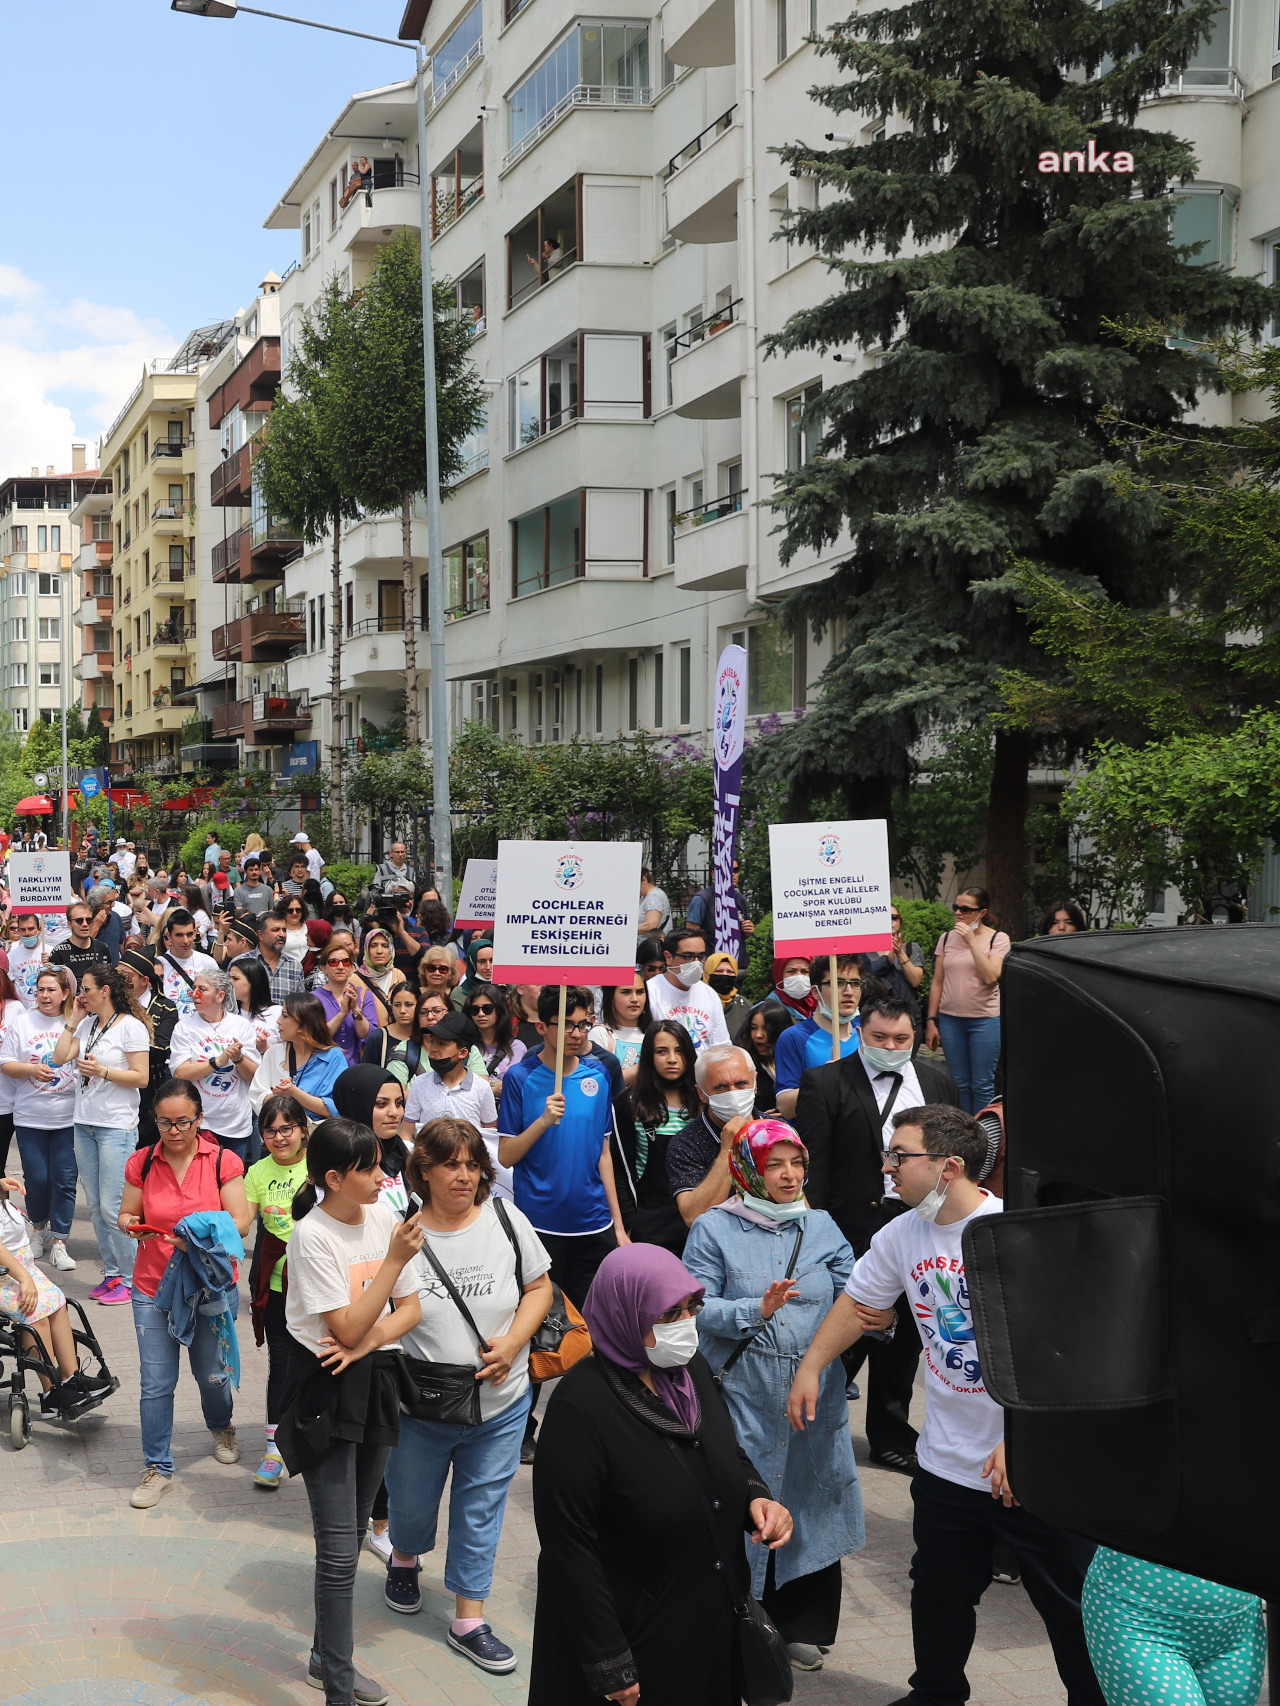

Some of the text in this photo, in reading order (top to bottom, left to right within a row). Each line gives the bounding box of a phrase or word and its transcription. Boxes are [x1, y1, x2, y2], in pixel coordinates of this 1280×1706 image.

[798, 874, 864, 886] İŞİTME ENGELLİ
[480, 886, 496, 894] OTİZ
[783, 884, 880, 899] ÇOCUKLAR VE AİLELER
[532, 899, 604, 910] COCHLEAR
[803, 895, 862, 907] SPOR KULÜBÜ
[777, 905, 888, 919] DAYANIŞMA YARDIMLAŞMA
[506, 913, 628, 926] IMPLANT DERNEĞİ
[815, 917, 852, 928] DERNEĞİ
[531, 929, 602, 943] ESKİŞEHİR
[521, 943, 610, 956] TEMSİLCİLİĞİ
[28, 1031, 60, 1046] ESKİŞE
[268, 1177, 295, 1191] Cool
[924, 1346, 987, 1394] ENGELSİZ SOKAK
